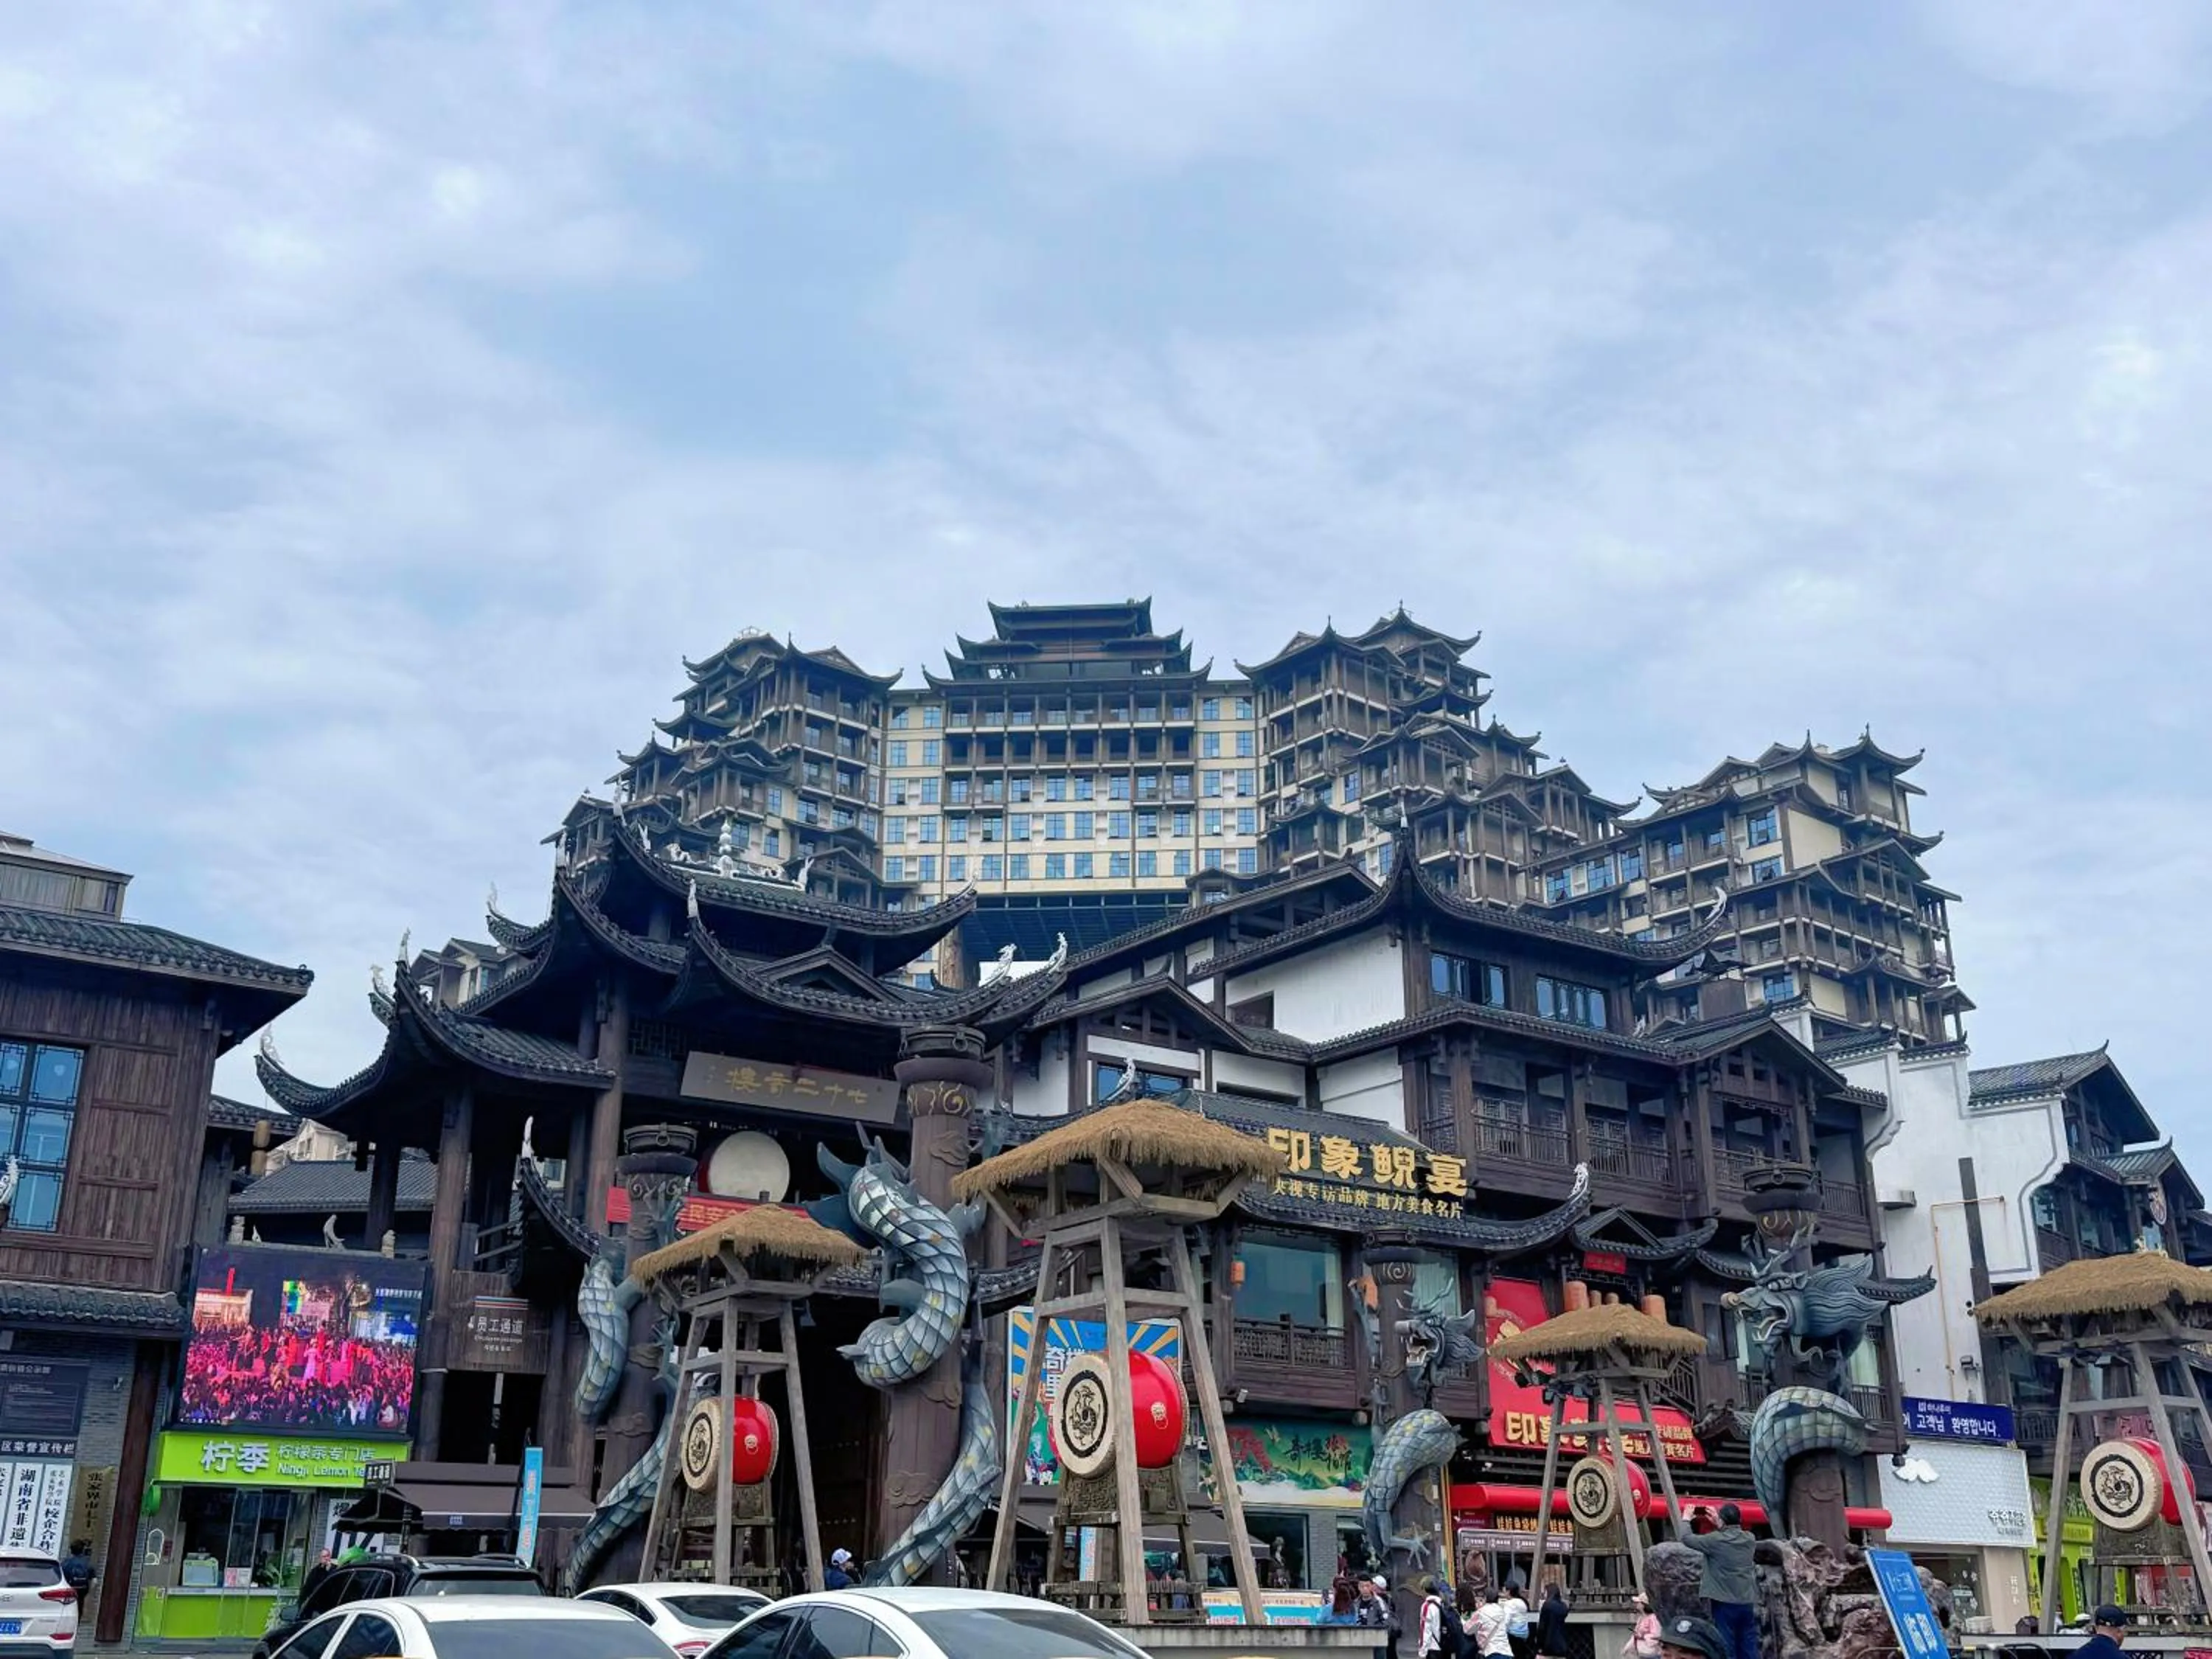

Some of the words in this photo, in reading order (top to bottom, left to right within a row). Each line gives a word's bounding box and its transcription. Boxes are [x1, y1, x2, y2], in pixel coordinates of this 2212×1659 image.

[1267, 1127, 1467, 1197] 印象鲵宴
[1376, 1194, 1464, 1220] 地方美食名片
[1916, 1413, 1945, 1433] 고객님
[201, 1439, 271, 1474] 柠季
[313, 1464, 351, 1477] Lemon
